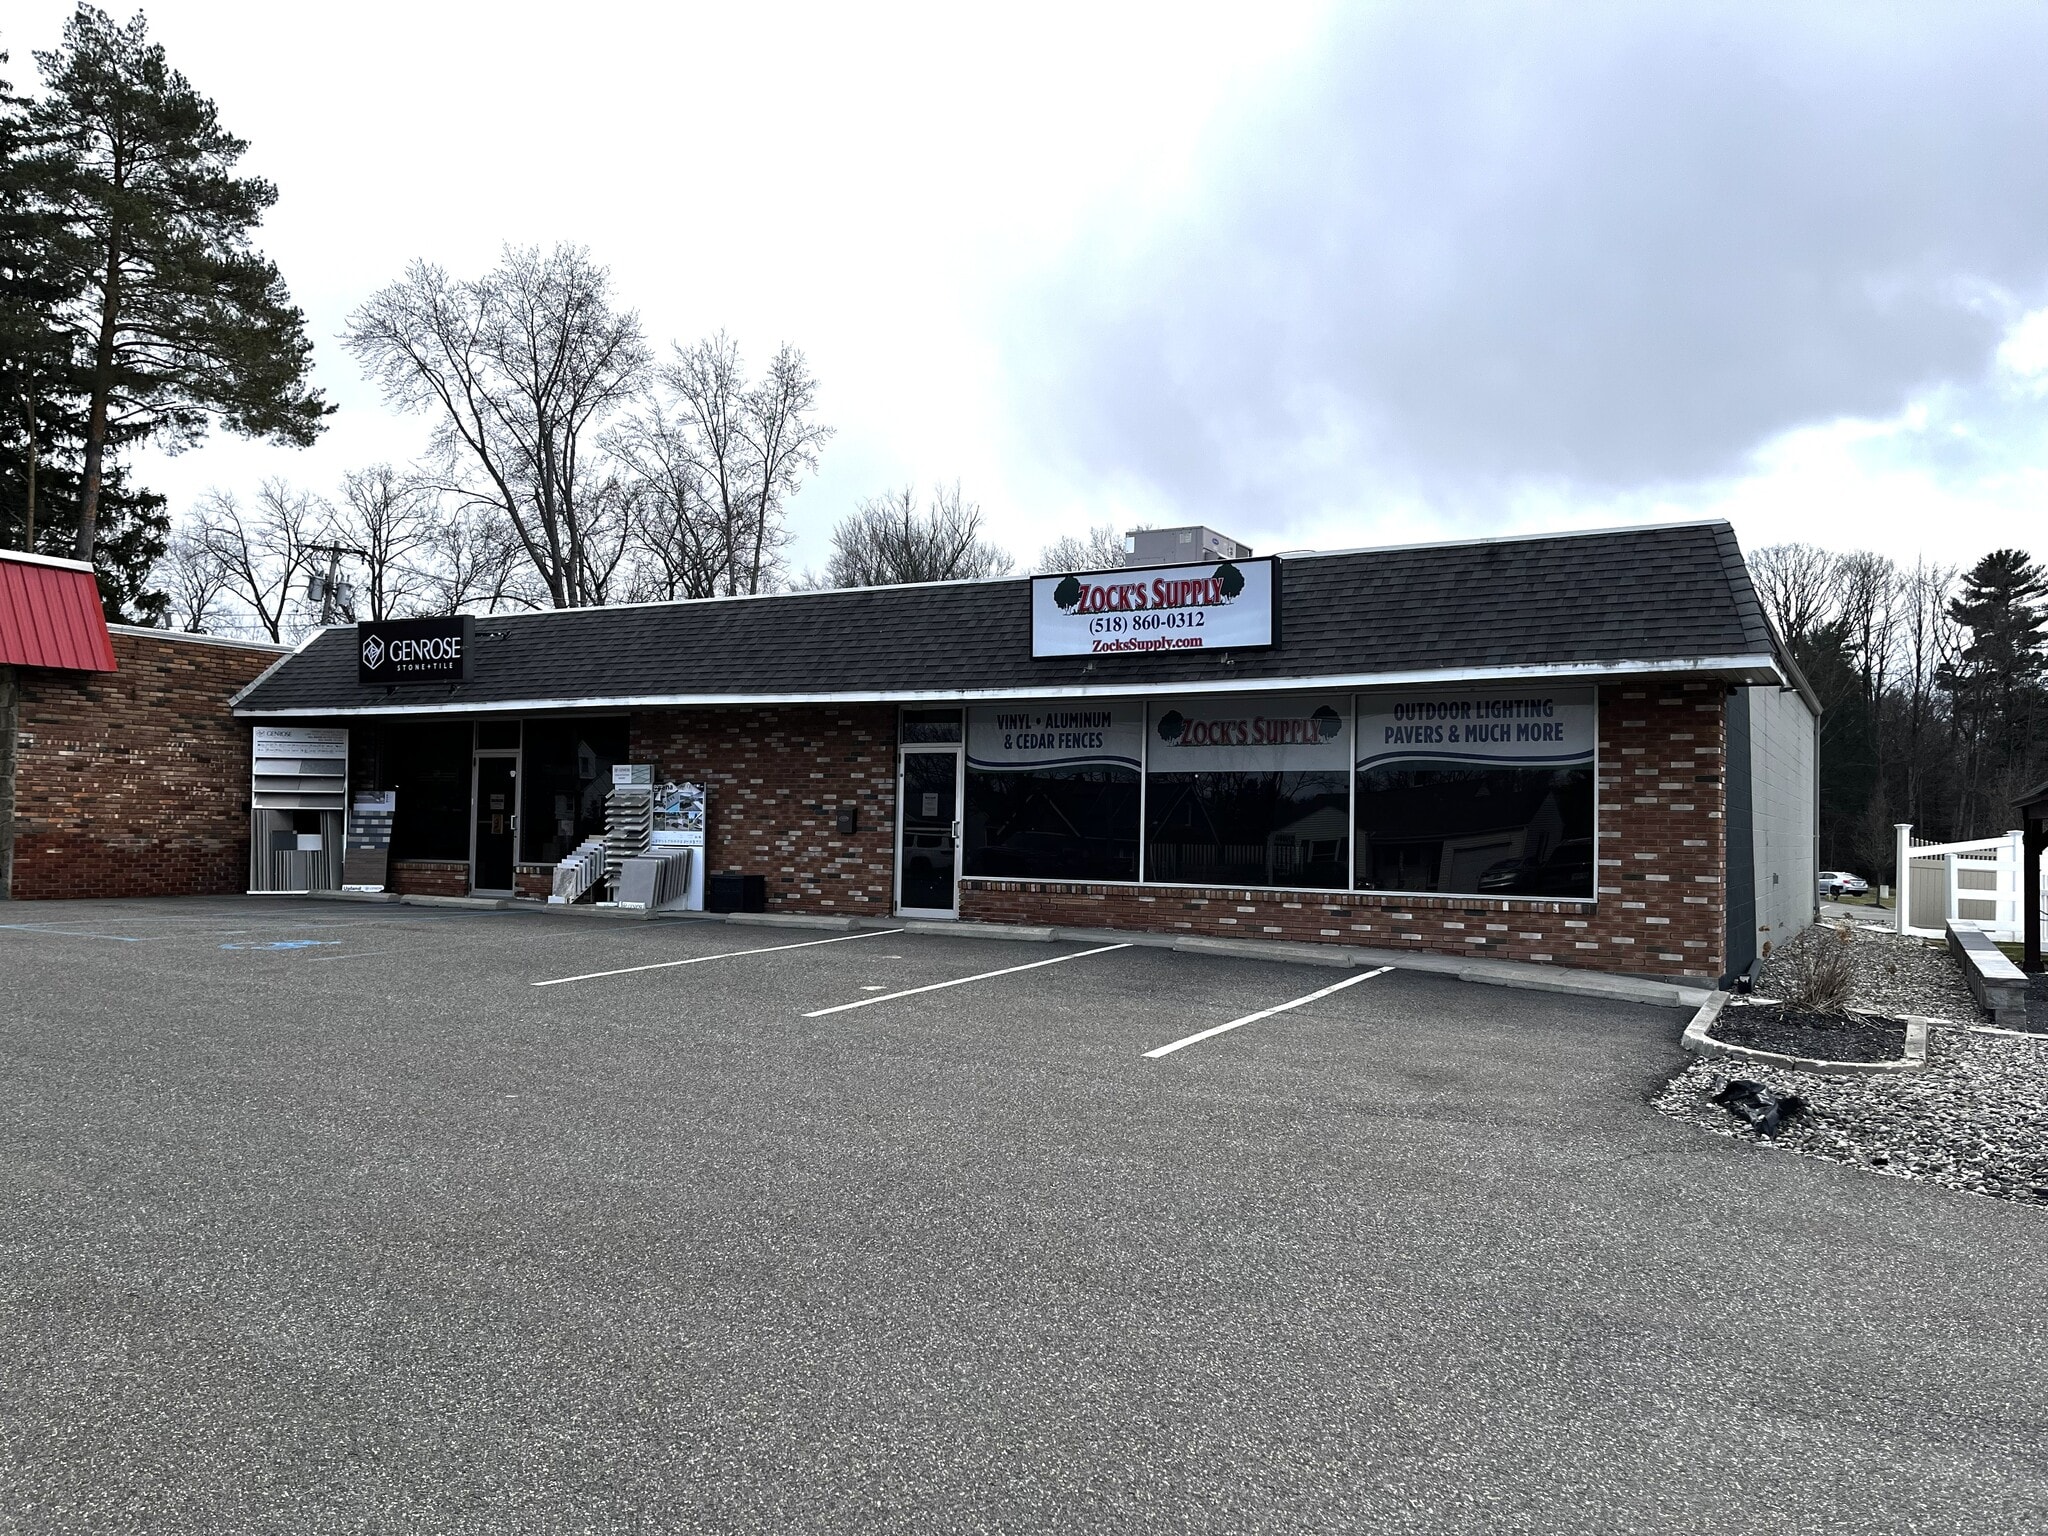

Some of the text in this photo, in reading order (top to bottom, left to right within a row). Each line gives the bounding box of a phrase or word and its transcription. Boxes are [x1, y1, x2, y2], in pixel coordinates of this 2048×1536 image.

[1077, 577, 1224, 612] ZOCK'S SUPPLY
[1089, 611, 1205, 636] (518) 860-0312
[389, 637, 461, 662] GENROSE
[1092, 636, 1203, 653] ZocksSupply.com
[397, 662, 453, 672] STONE+TILE
[997, 711, 1111, 730] VINYL ALUMINUM
[1394, 699, 1554, 721] OUTDOOR LIGHTING
[1004, 732, 1103, 749] & CEDAR FENCES
[1180, 715, 1322, 745] ZOCK'S SUPPLY
[1384, 722, 1564, 744] PAVERS & MUCH MORE
